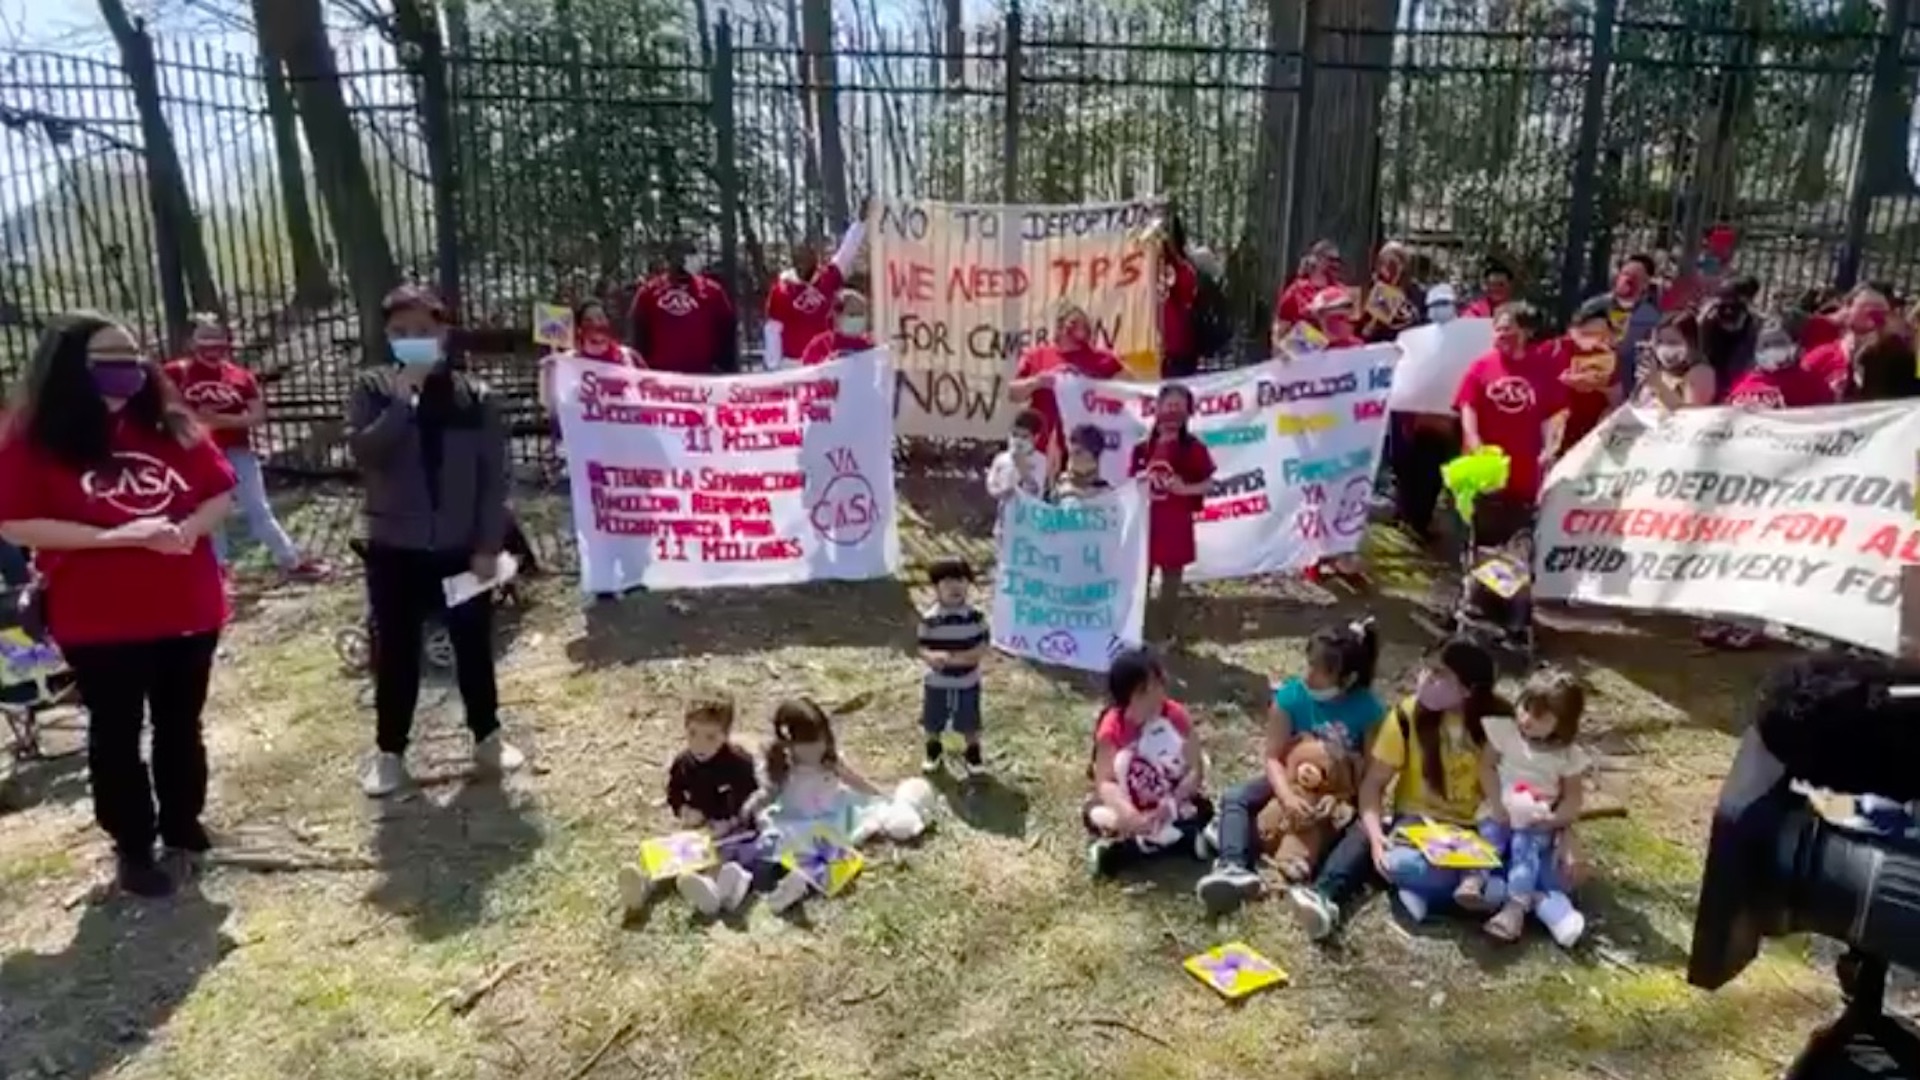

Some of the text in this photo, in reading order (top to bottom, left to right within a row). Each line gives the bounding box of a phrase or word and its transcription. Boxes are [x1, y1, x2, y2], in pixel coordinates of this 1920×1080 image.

[879, 204, 929, 240] NO
[955, 208, 1000, 242] TO
[888, 261, 935, 302] WE
[948, 261, 1029, 303] NEED
[892, 313, 1122, 361] FOR CAMERN
[892, 368, 1001, 422] NOW
[824, 447, 860, 473] VA
[79, 466, 192, 497] CASA
[1577, 469, 1648, 501] STOP
[1561, 507, 1920, 563] CITIZENSHIP FOR AL
[1544, 546, 1903, 608] COVID RECOVERY FO
